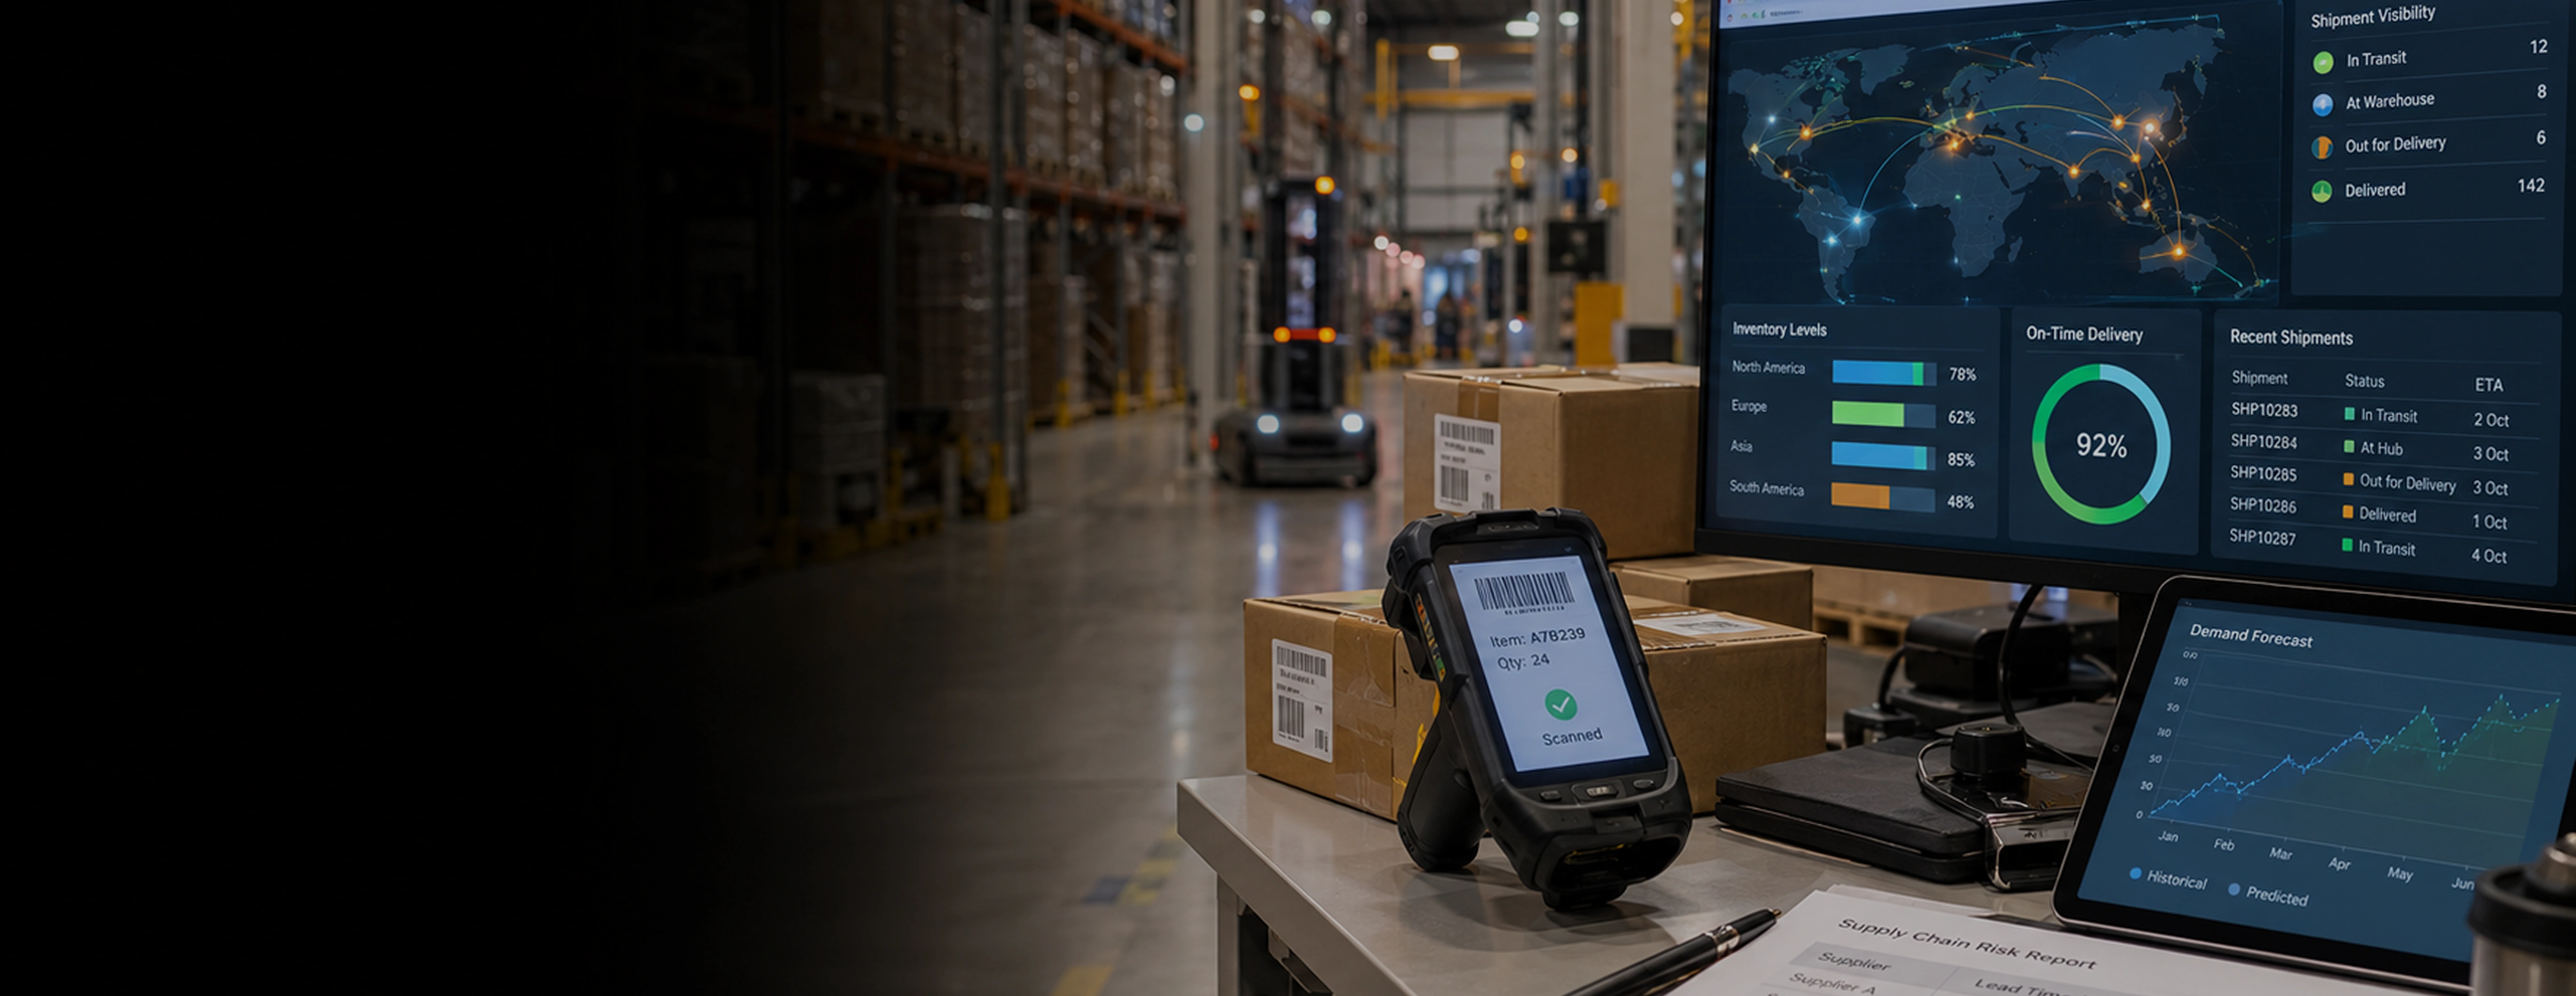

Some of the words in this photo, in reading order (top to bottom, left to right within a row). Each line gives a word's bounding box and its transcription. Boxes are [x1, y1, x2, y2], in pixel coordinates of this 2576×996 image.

[2311, 10, 2375, 30] Shipment
[2378, 4, 2436, 22] Visibility
[2530, 39, 2548, 54] 12
[2347, 54, 2360, 67] In
[2362, 50, 2407, 65] Transit
[2537, 84, 2547, 99] 8
[2346, 96, 2360, 110] At
[2364, 93, 2435, 108] Warehouse
[2346, 139, 2369, 153] Out
[2372, 137, 2391, 152] for
[2394, 136, 2447, 152] Delivery
[2536, 129, 2546, 145] 6
[2346, 182, 2406, 197] Delivered
[2518, 177, 2545, 193] 142
[1733, 321, 1787, 339] Inventory
[1790, 322, 1827, 337] Levels
[2026, 325, 2084, 341] On-Time
[2088, 326, 2144, 345] Delivery
[2231, 328, 2277, 344] Recent
[2280, 329, 2353, 347] Shipments
[1732, 360, 1761, 372] North
[1763, 361, 1806, 375] America
[1950, 367, 1977, 381] 78%
[2232, 370, 2288, 386] Shipment
[2345, 373, 2385, 388] Status
[2476, 377, 2504, 392] ETA
[1732, 399, 1768, 415] Europe
[2232, 402, 2298, 418] SHP10283
[1948, 410, 1976, 424] 62%
[2362, 408, 2373, 421] In
[2376, 408, 2418, 423] Transit
[2474, 412, 2483, 426] 2
[2486, 412, 2509, 427] Oct
[1730, 440, 1753, 453] Asia
[2077, 432, 2127, 458] 92%
[2232, 433, 2297, 449] SHP10284
[2360, 441, 2375, 454] At
[2378, 442, 2403, 456] Hub
[1948, 452, 1976, 467] 85%
[2473, 446, 2482, 460] 3
[2486, 446, 2509, 462] Oct
[2231, 465, 2297, 482] SHP10285
[1730, 479, 1760, 493] South
[1761, 482, 1805, 497] America
[2360, 473, 2382, 488] Out
[2385, 474, 2403, 489] for
[2406, 476, 2457, 496] Delivery
[2473, 480, 2482, 494] 3
[2485, 481, 2508, 496] Oct
[1947, 495, 1975, 509] 48%
[2231, 496, 2297, 514] SHP10286
[2360, 506, 2416, 523] Delivered
[2473, 514, 2479, 528] 1
[2484, 514, 2507, 530] Oct
[2230, 528, 2296, 546] SHP10287
[2359, 539, 2370, 553] In
[2374, 540, 2416, 557] Transit
[2472, 548, 2480, 562] 4
[2484, 548, 2507, 564] Oct
[1490, 635, 1526, 648] Item:
[2190, 624, 2249, 641] Demand
[2251, 630, 2313, 648] Forecast
[1497, 657, 1526, 671] Qty:
[1531, 653, 1550, 666] 24
[1542, 727, 1603, 746] Scanned
[2136, 810, 2144, 819] 0
[2158, 830, 2179, 843] Jan
[2214, 838, 2235, 851] Feb
[2269, 847, 2293, 860] Mar
[2328, 857, 2351, 871] Apr
[2147, 870, 2208, 890] Historical
[2387, 867, 2414, 884] May
[2451, 877, 2475, 891] Jun
[2246, 886, 2309, 907] Predicted
[1839, 919, 1908, 939] Supply
[1912, 932, 1971, 948] Chain
[1976, 942, 2020, 957] Risk
[2025, 950, 2096, 970] Report
[1818, 952, 1891, 971] Supplier
[1789, 972, 1860, 992] Supplier
[1861, 986, 1876, 996] A
[1975, 979, 2023, 994] Lead
[2028, 986, 2072, 996] Tim
